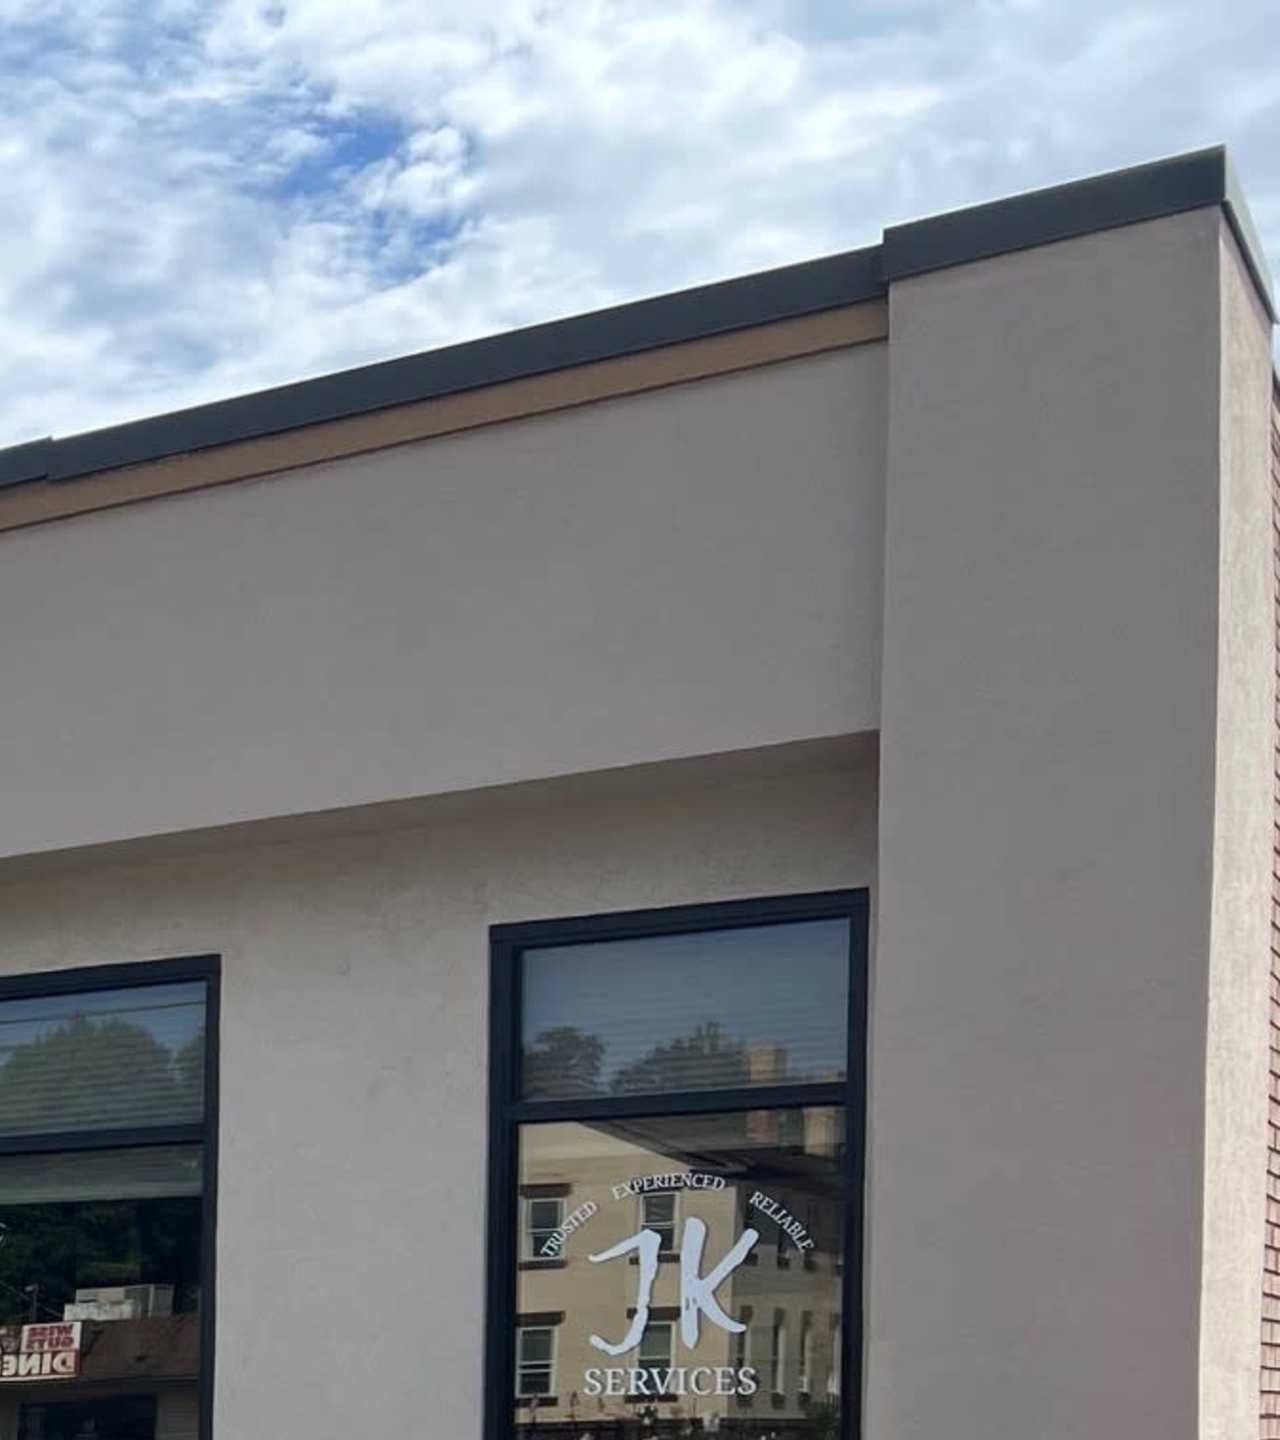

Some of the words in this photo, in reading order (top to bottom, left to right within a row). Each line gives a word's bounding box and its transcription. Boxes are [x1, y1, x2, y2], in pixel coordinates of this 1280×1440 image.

[540, 1200, 598, 1257] TRUSTED
[612, 1172, 726, 1200] EXPERIENCED
[749, 1191, 815, 1253] RELIABLE
[588, 1216, 759, 1356] JK
[584, 1366, 757, 1396] SERVICES
